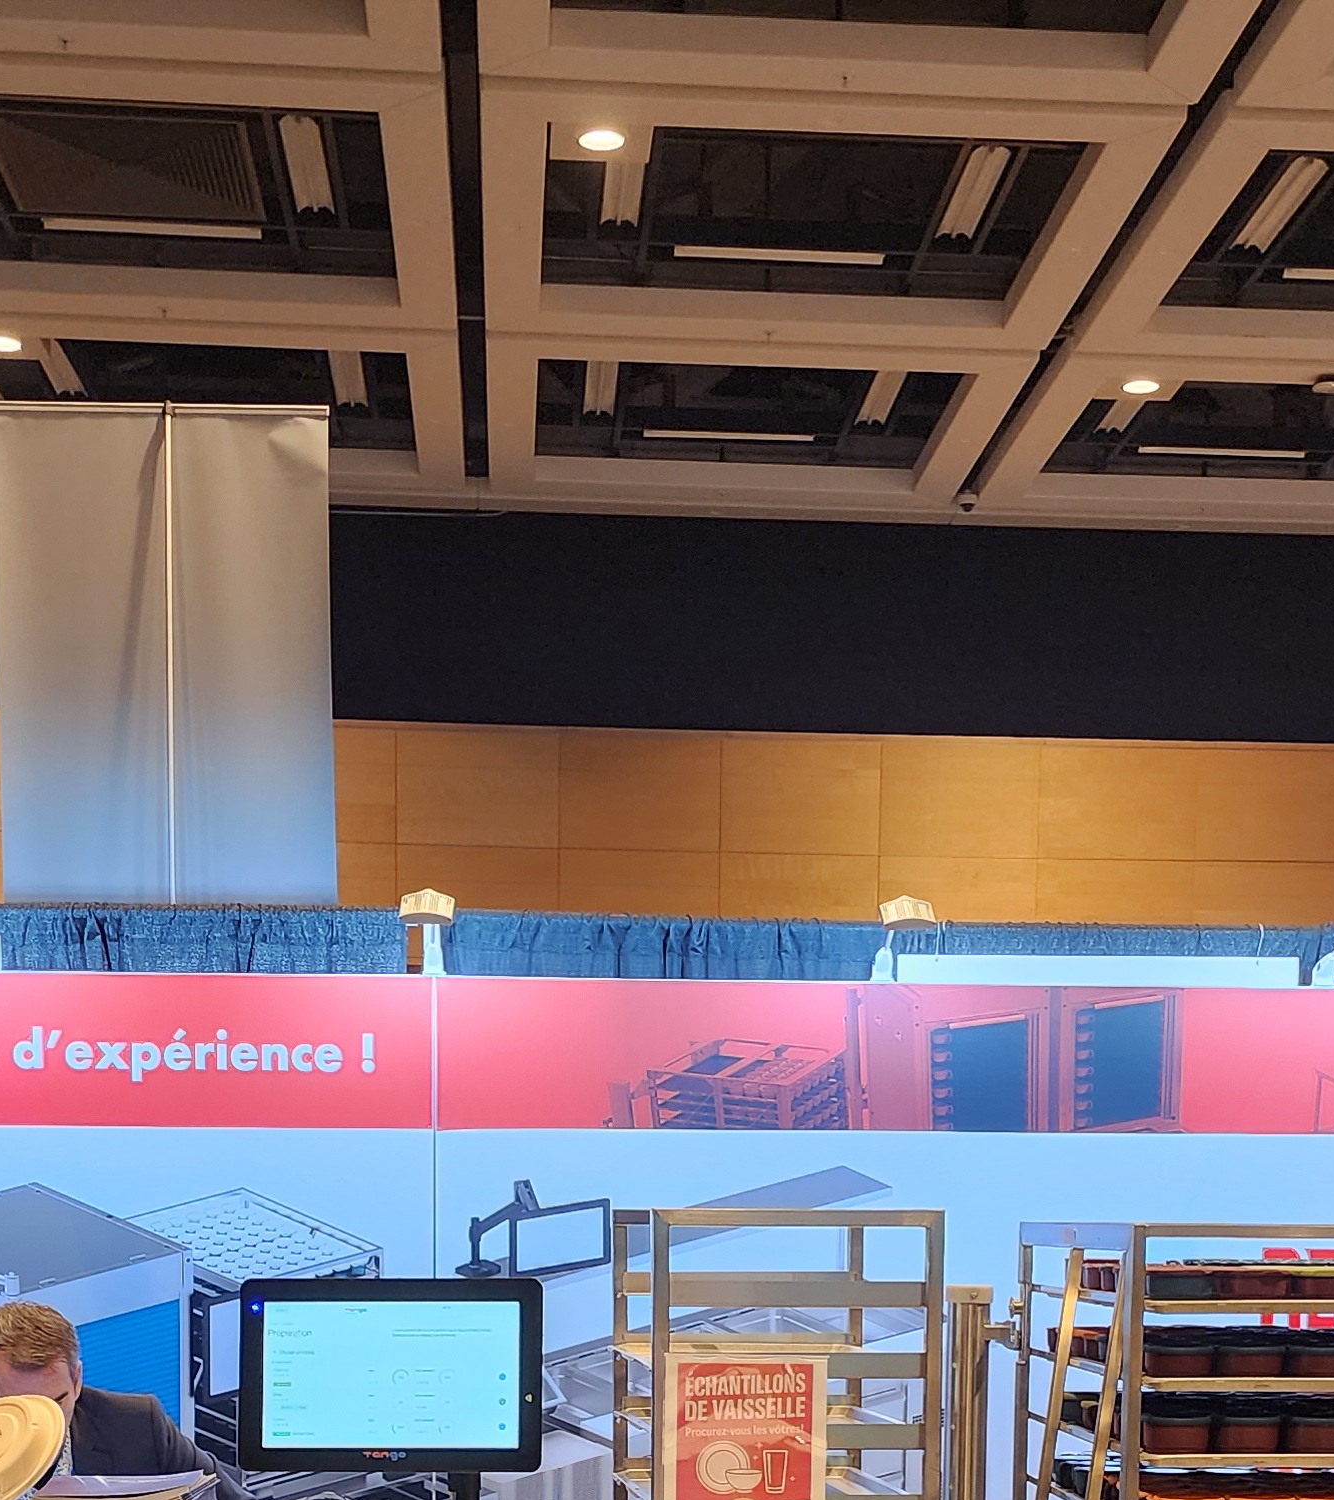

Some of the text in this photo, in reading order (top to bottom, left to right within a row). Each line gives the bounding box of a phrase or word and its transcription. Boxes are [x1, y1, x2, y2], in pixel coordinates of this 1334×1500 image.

[12, 1025, 343, 1082] d'expérience
[361, 1032, 377, 1073] !
[685, 1371, 806, 1397] ÉCHANTILLONS
[684, 1396, 806, 1421] DE VAISSELLE
[685, 1426, 752, 1437] Procurez-vous
[753, 1424, 767, 1435] les
